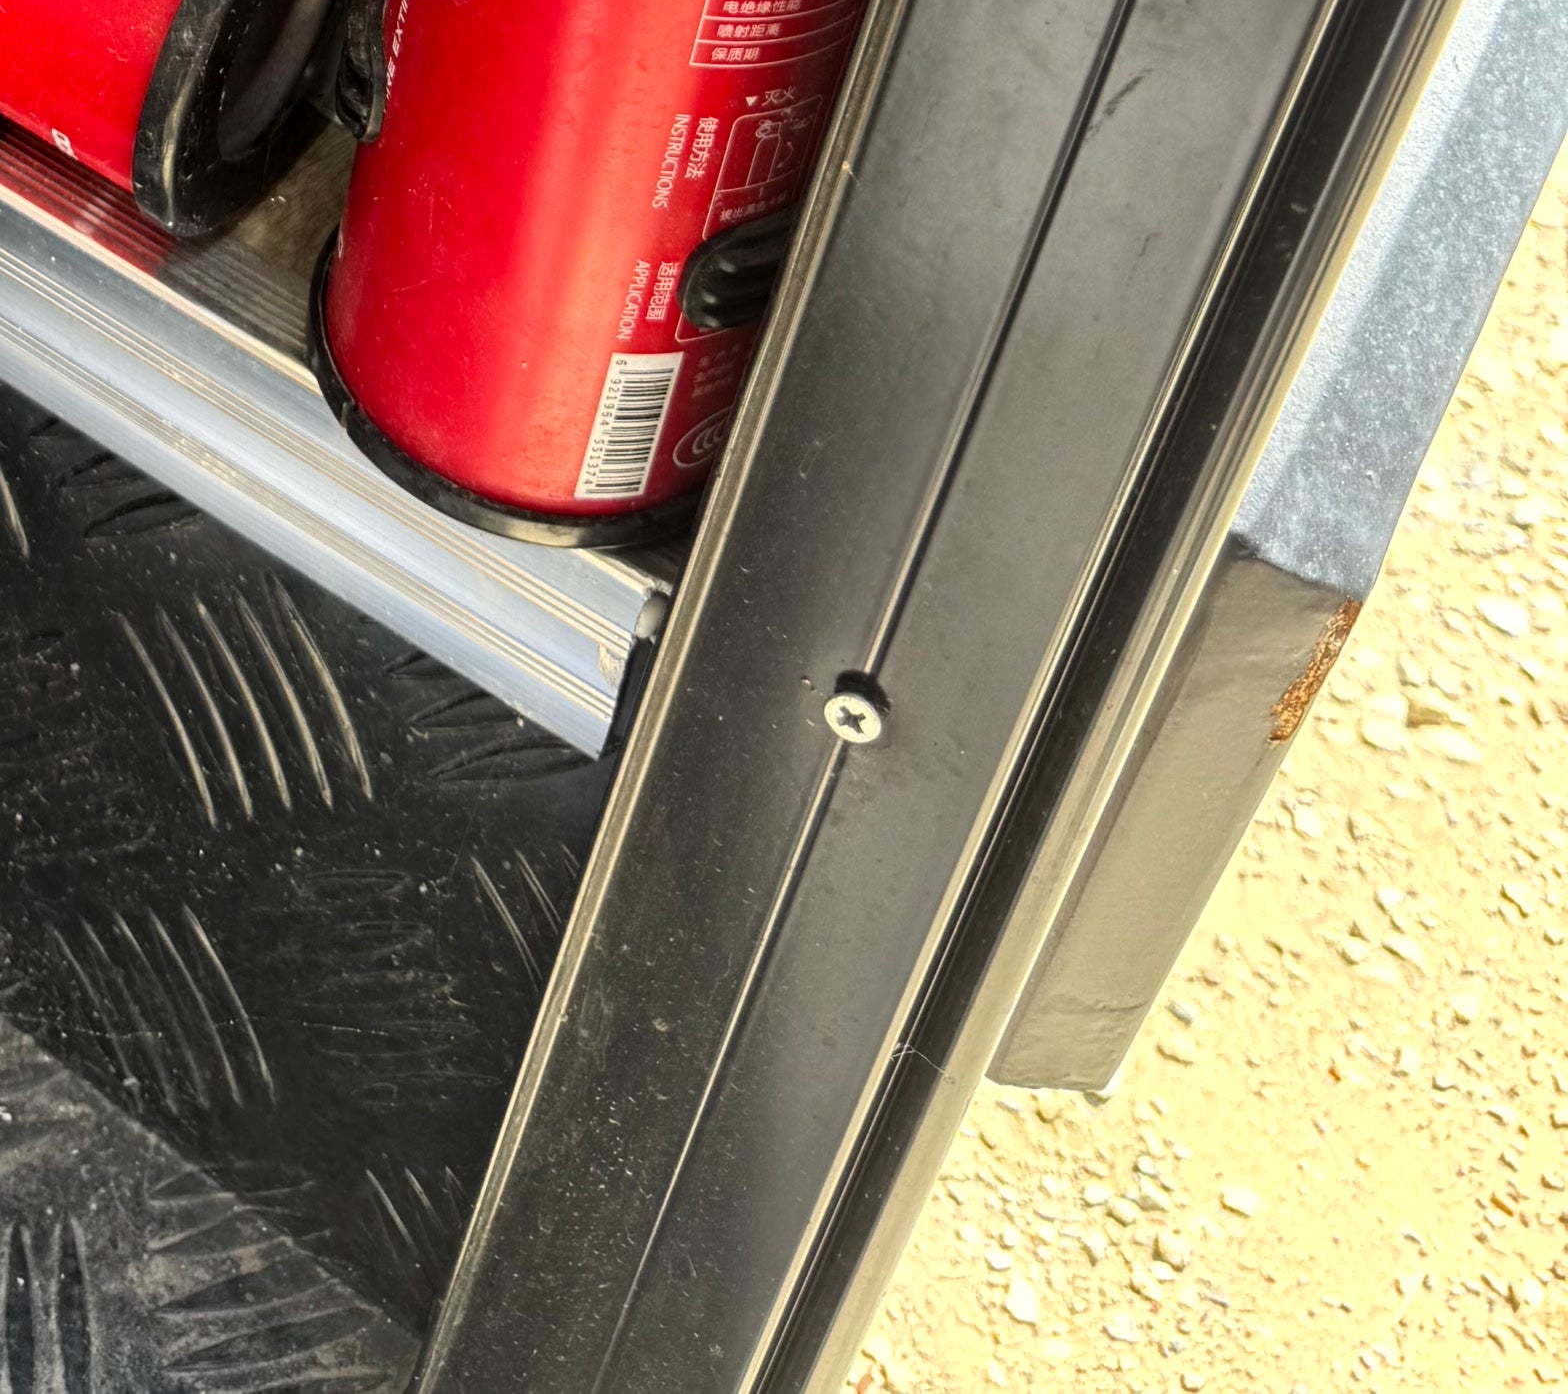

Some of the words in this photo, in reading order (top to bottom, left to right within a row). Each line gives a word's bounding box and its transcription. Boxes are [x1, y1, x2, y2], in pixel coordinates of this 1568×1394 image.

[711, 47, 760, 62] 保质期
[652, 113, 691, 208] INSTRUCTIONS
[684, 116, 720, 179] 使用方法
[616, 259, 651, 341] APPLICATION
